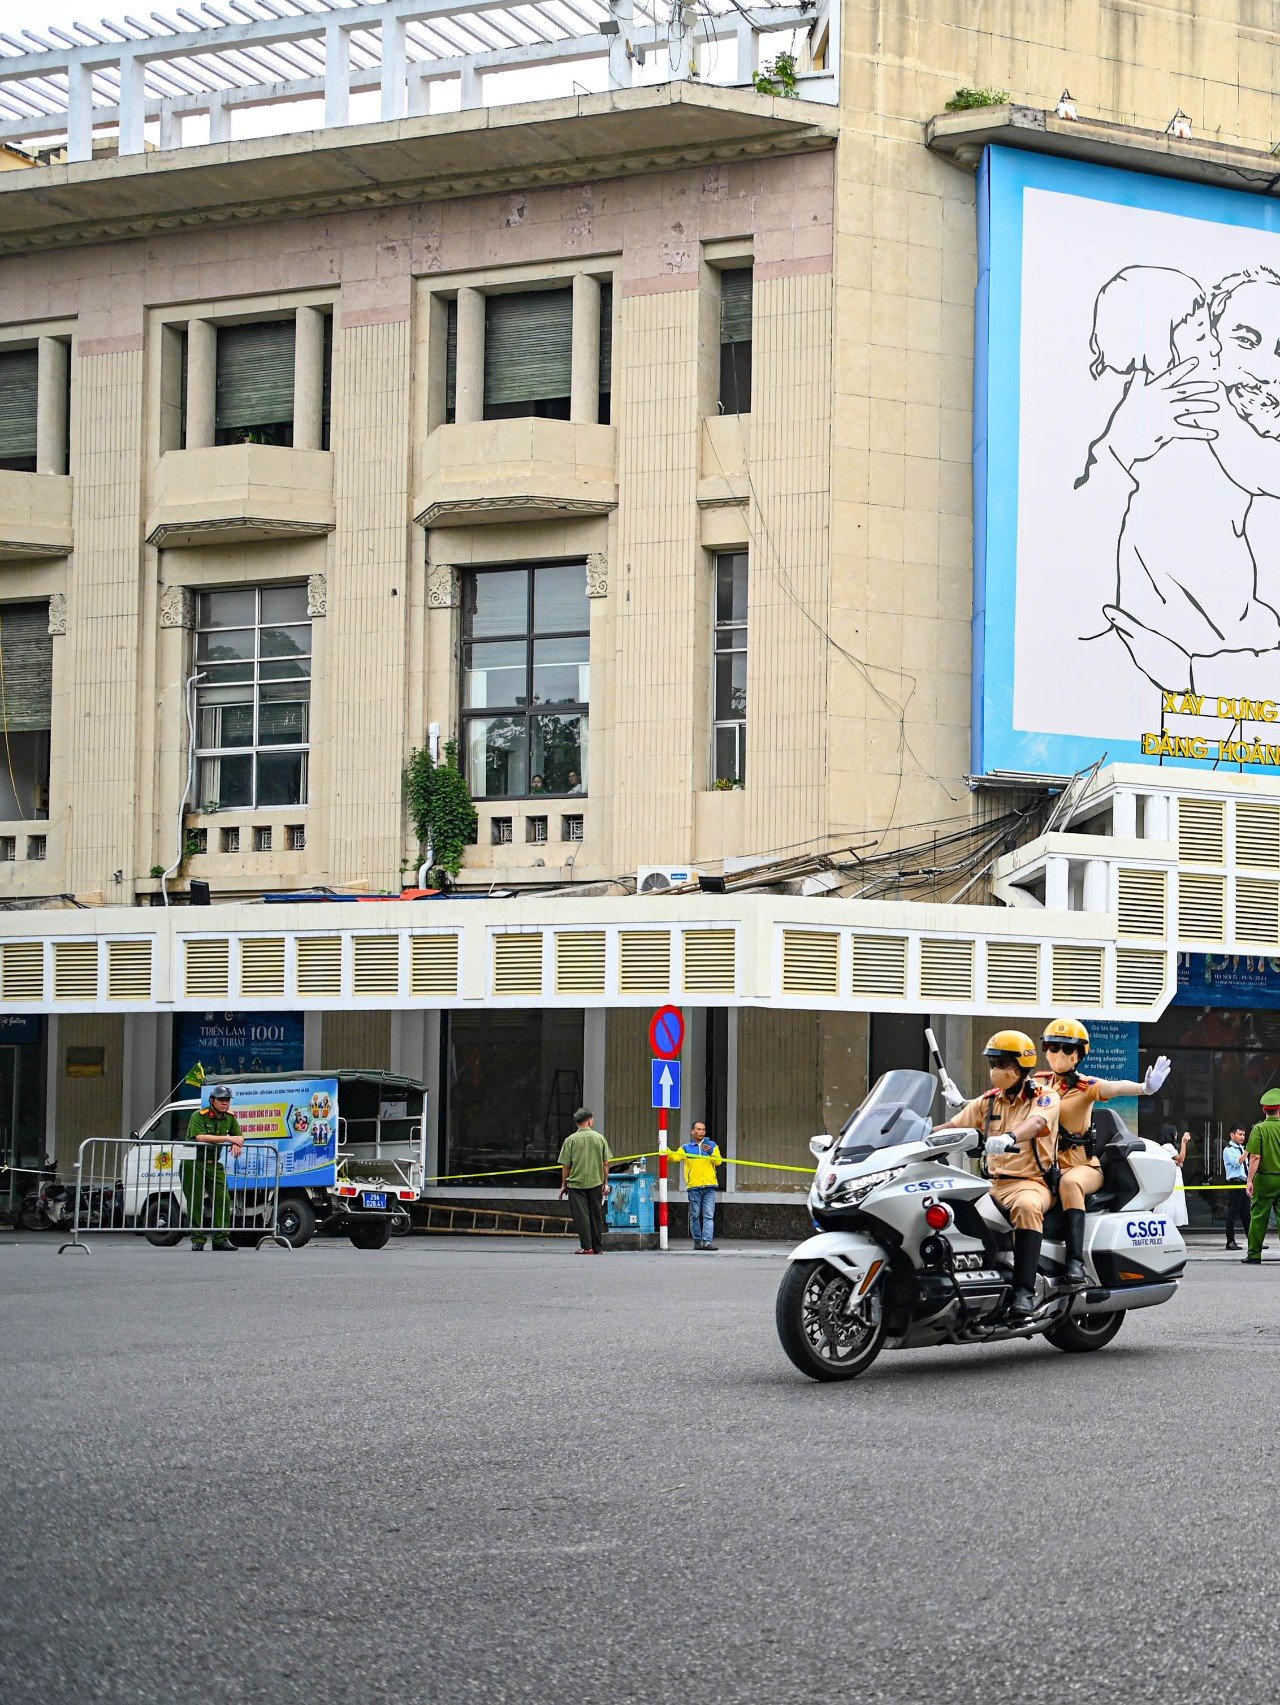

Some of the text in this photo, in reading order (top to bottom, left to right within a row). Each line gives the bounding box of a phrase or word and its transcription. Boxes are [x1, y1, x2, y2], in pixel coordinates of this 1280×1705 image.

[1162, 687, 1206, 716] XÂY
[1217, 696, 1279, 725] DỰNG
[250, 1025, 285, 1041] 1001
